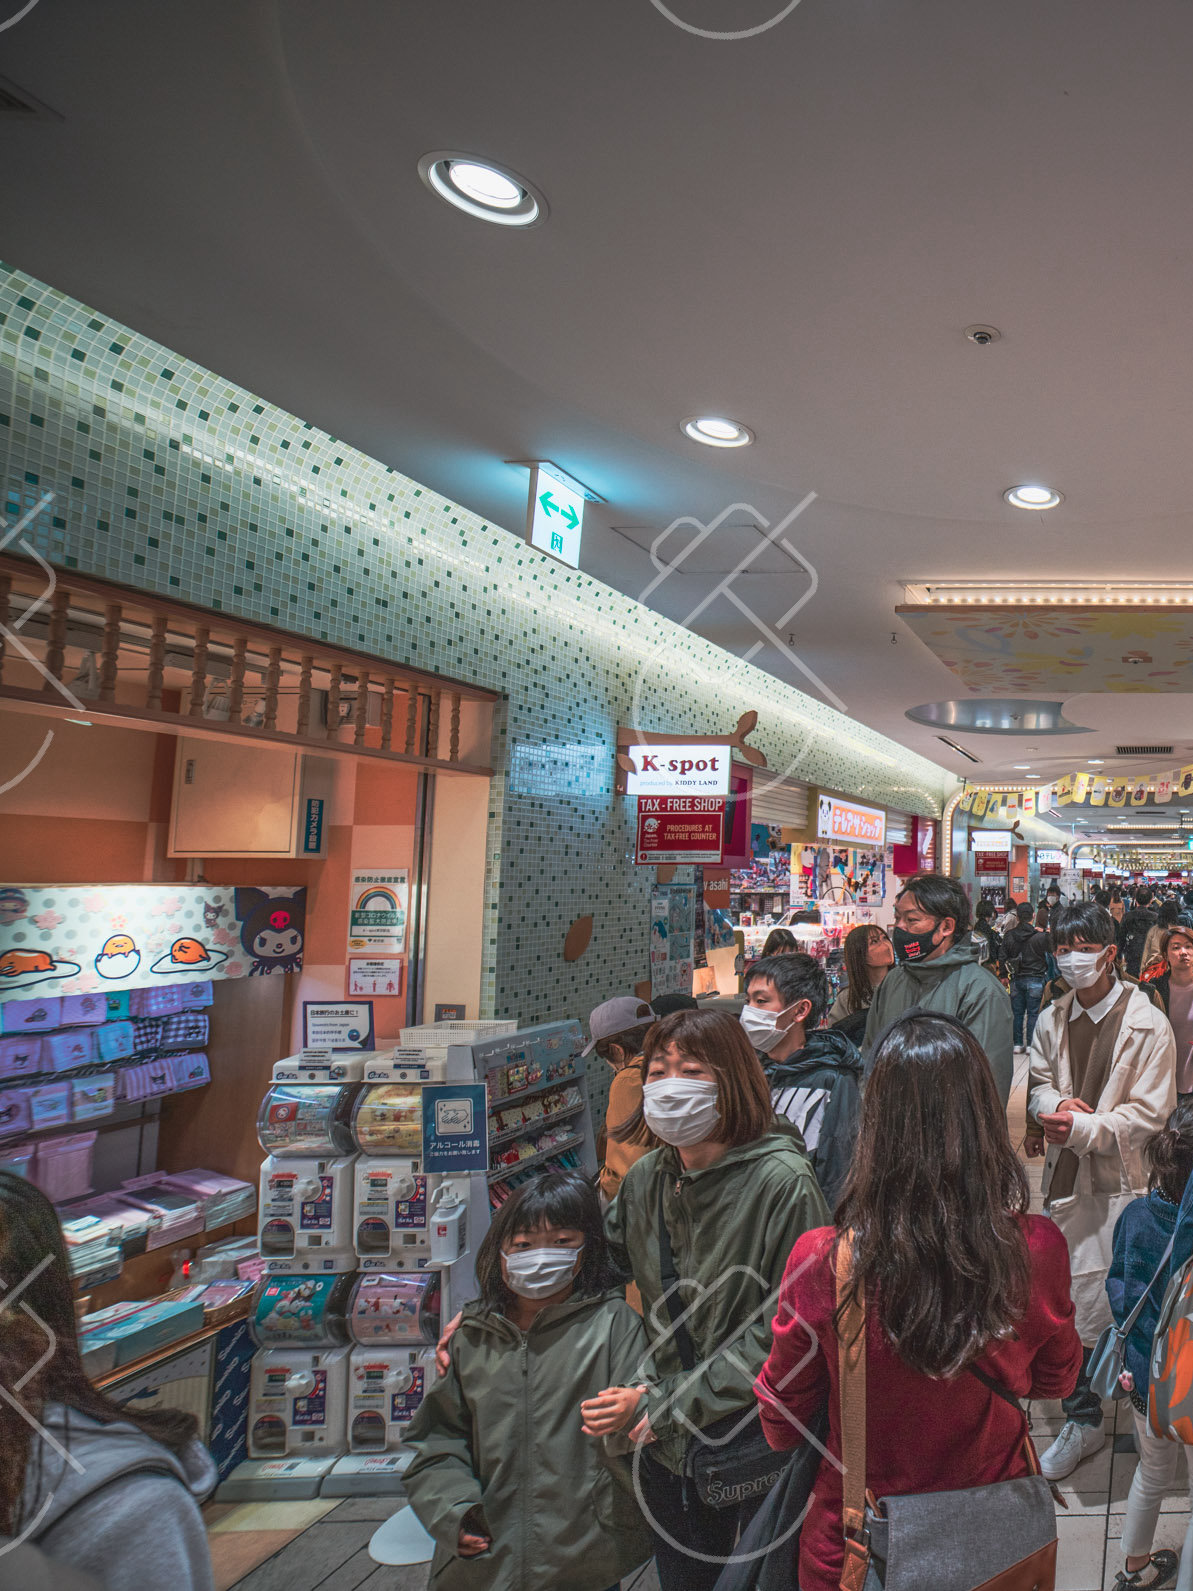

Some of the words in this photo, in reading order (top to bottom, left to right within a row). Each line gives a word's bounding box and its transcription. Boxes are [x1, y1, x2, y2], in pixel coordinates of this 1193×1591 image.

[641, 754, 719, 776] K-spot
[640, 799, 660, 811] TAX
[667, 798, 692, 811] FREE
[694, 798, 723, 811] SHOP
[666, 824, 703, 832] PROCEDURES
[704, 824, 713, 832] AT
[663, 832, 690, 840] TAX-FREE
[690, 832, 717, 840] COUNTER
[709, 878, 729, 891] asahi
[429, 1139, 481, 1150] アルコール消毒
[707, 1466, 788, 1504] Supre
